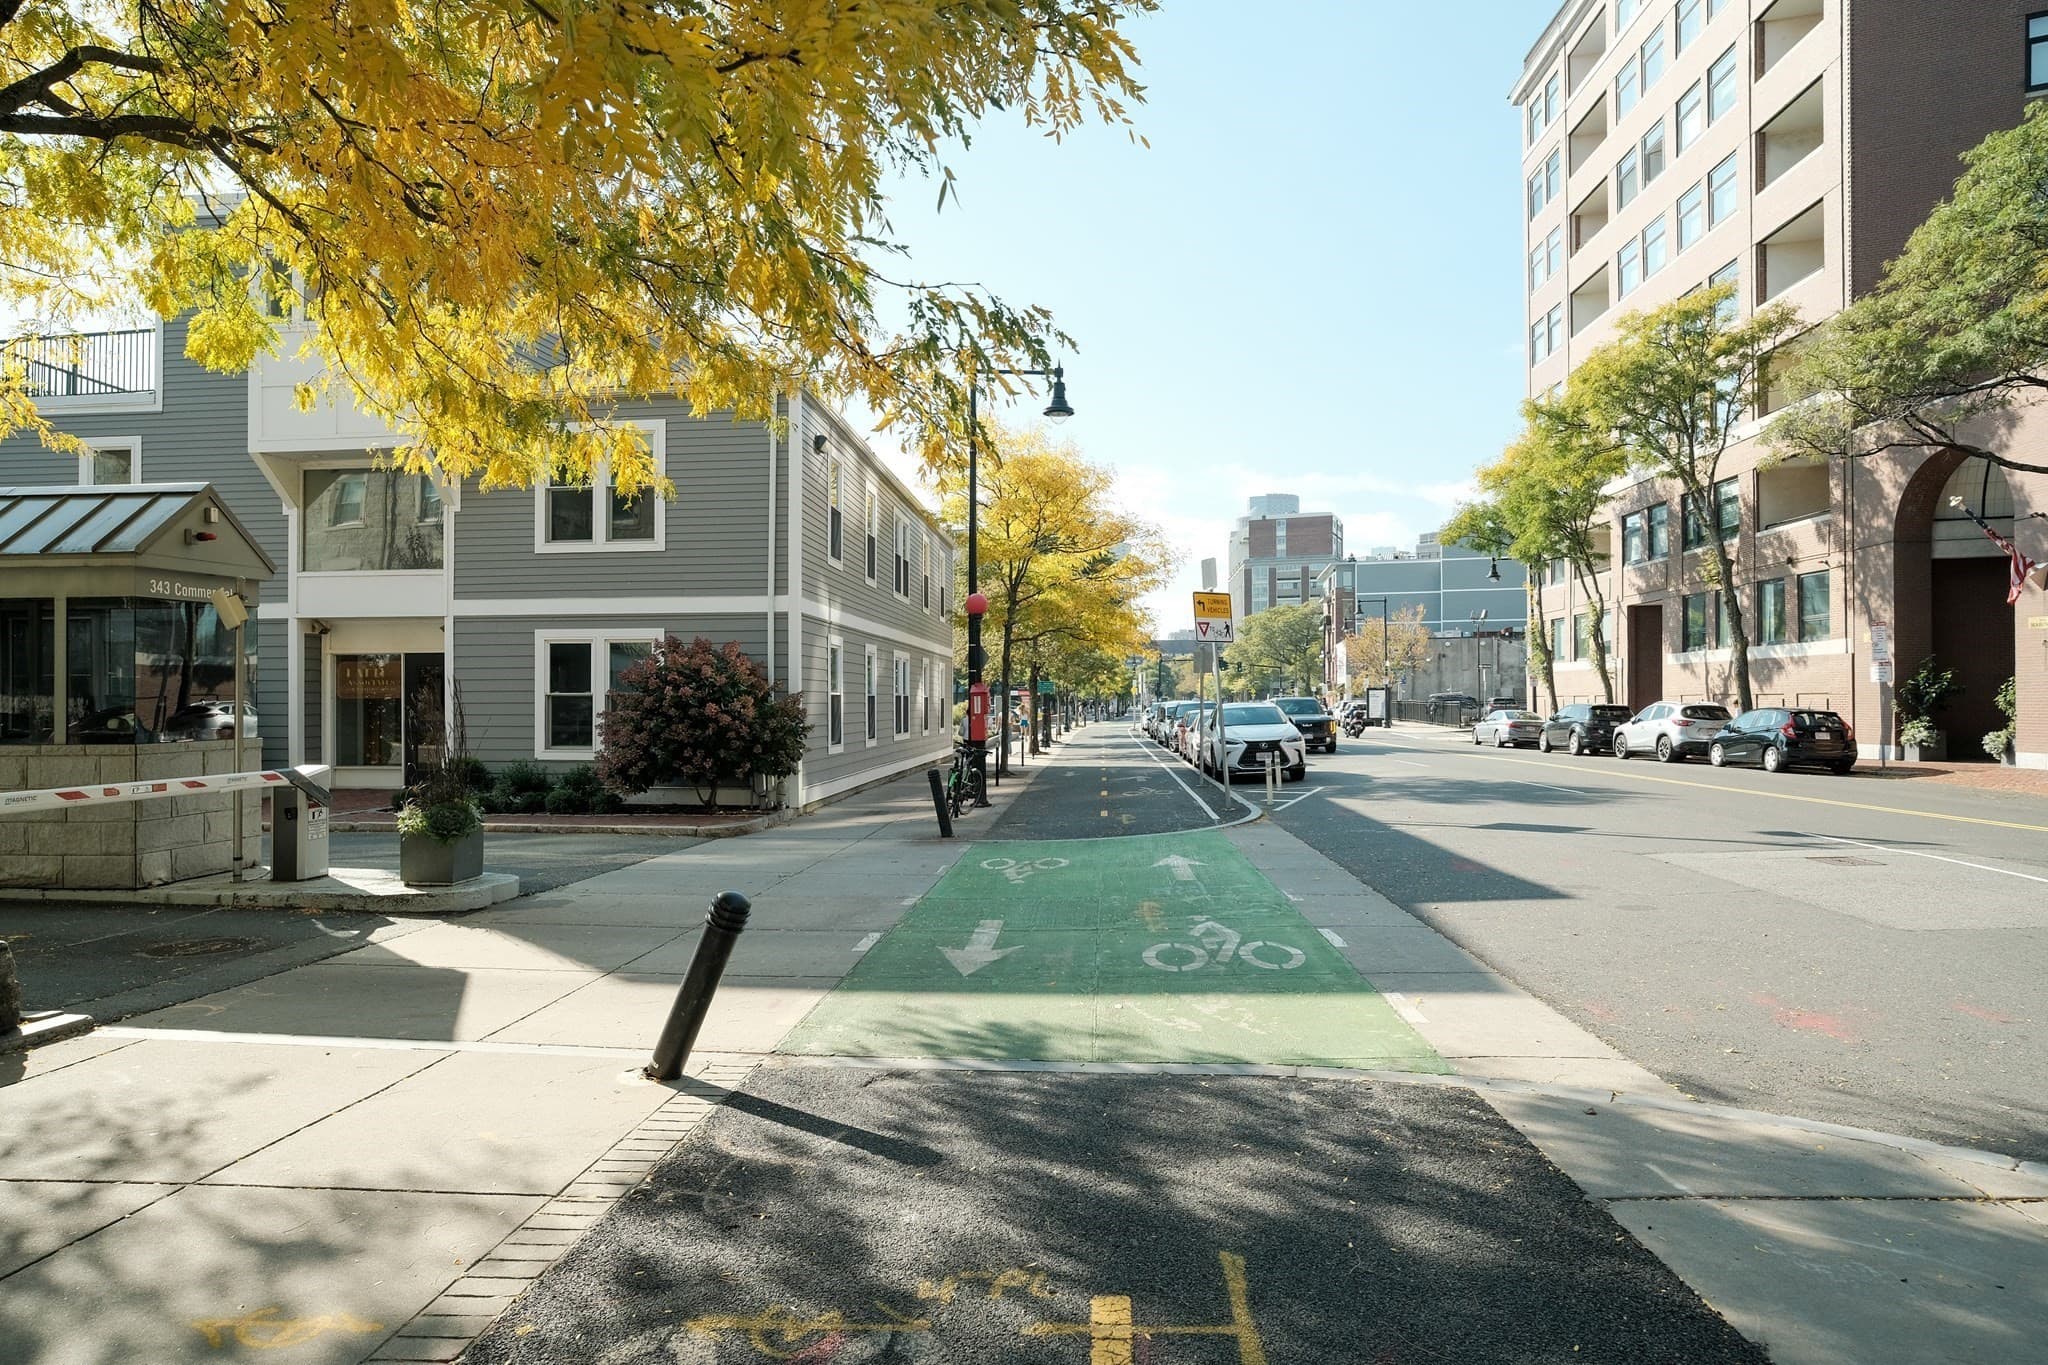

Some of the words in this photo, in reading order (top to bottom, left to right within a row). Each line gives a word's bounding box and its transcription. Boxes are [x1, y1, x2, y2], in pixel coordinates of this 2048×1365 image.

[149, 579, 171, 595] 343
[174, 582, 234, 599] Commeral
[1206, 606, 1229, 614] VEHICLES
